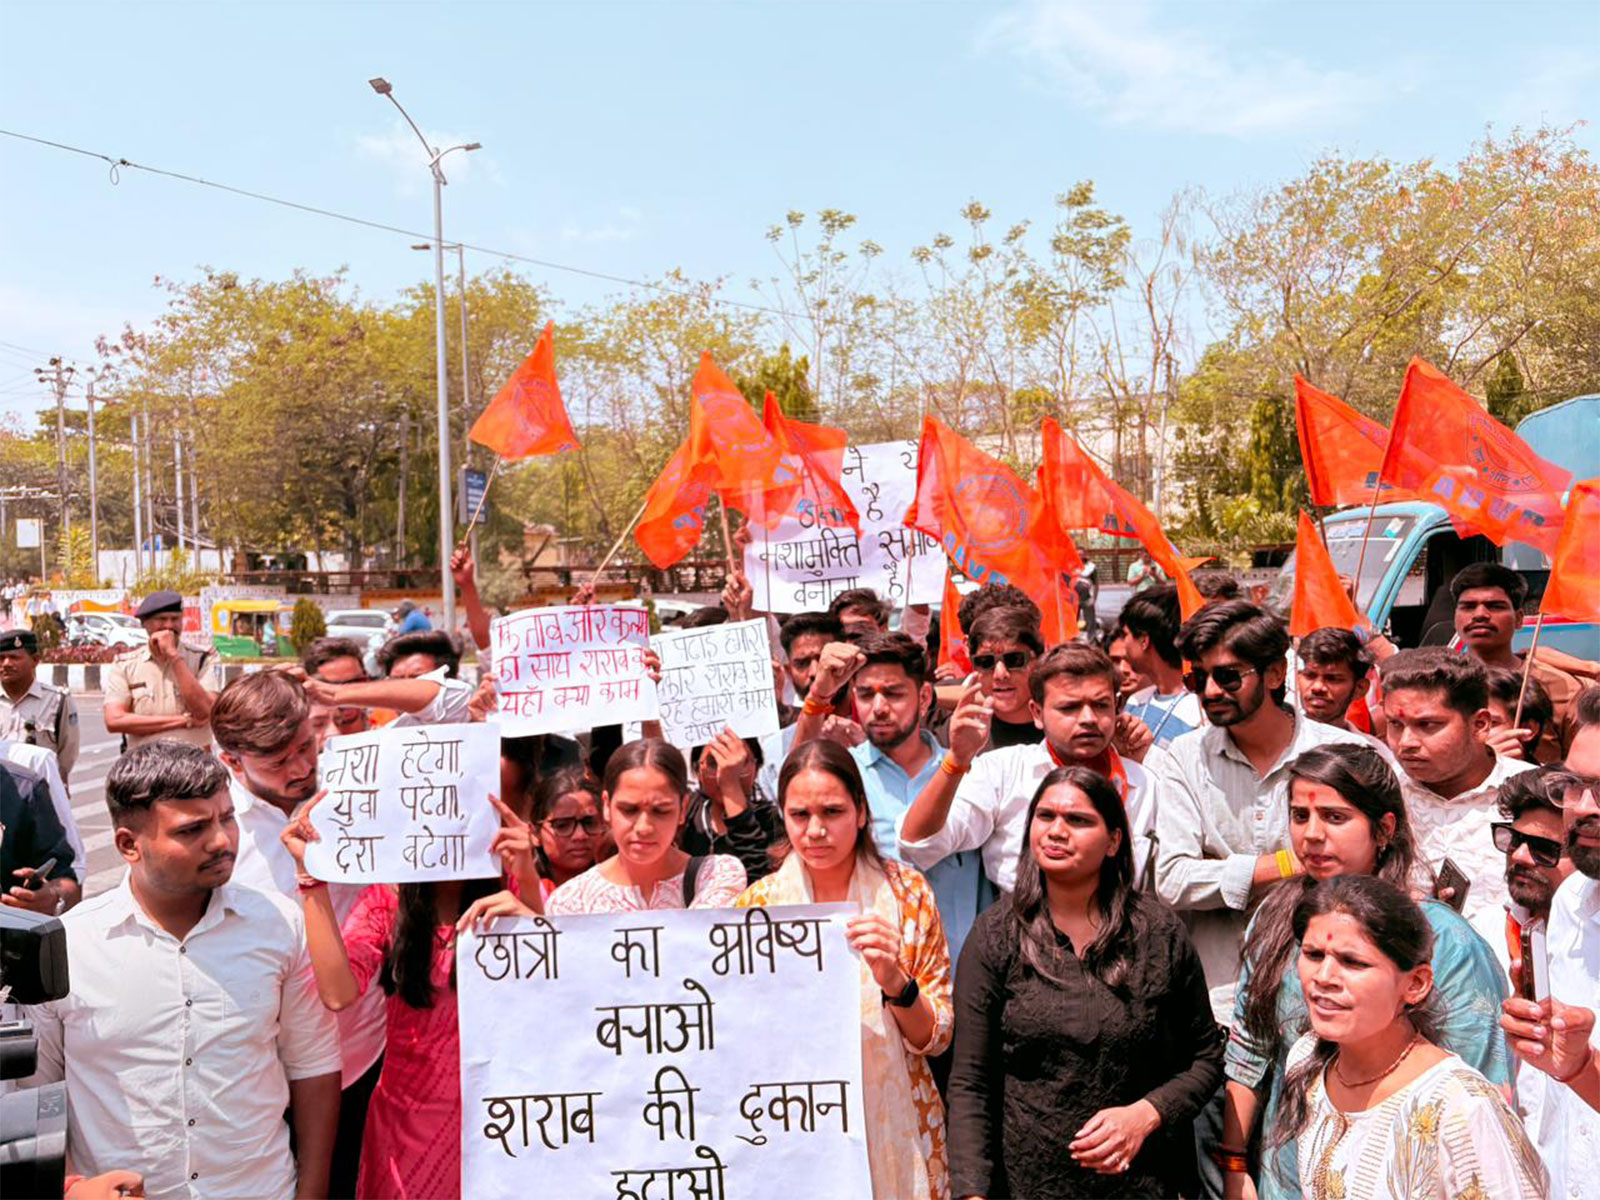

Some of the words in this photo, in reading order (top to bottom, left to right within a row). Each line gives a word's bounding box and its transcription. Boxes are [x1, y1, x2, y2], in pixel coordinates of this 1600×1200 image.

[326, 744, 380, 784] नशा
[328, 789, 380, 827] युवा
[336, 827, 385, 874] देश
[474, 917, 563, 981] छात्रो
[611, 926, 665, 978] का
[709, 907, 832, 976] भविष्य
[595, 977, 716, 1056] बचाओ
[481, 1092, 603, 1157] शराब
[642, 1065, 701, 1141] की
[736, 1080, 851, 1146] दुकान
